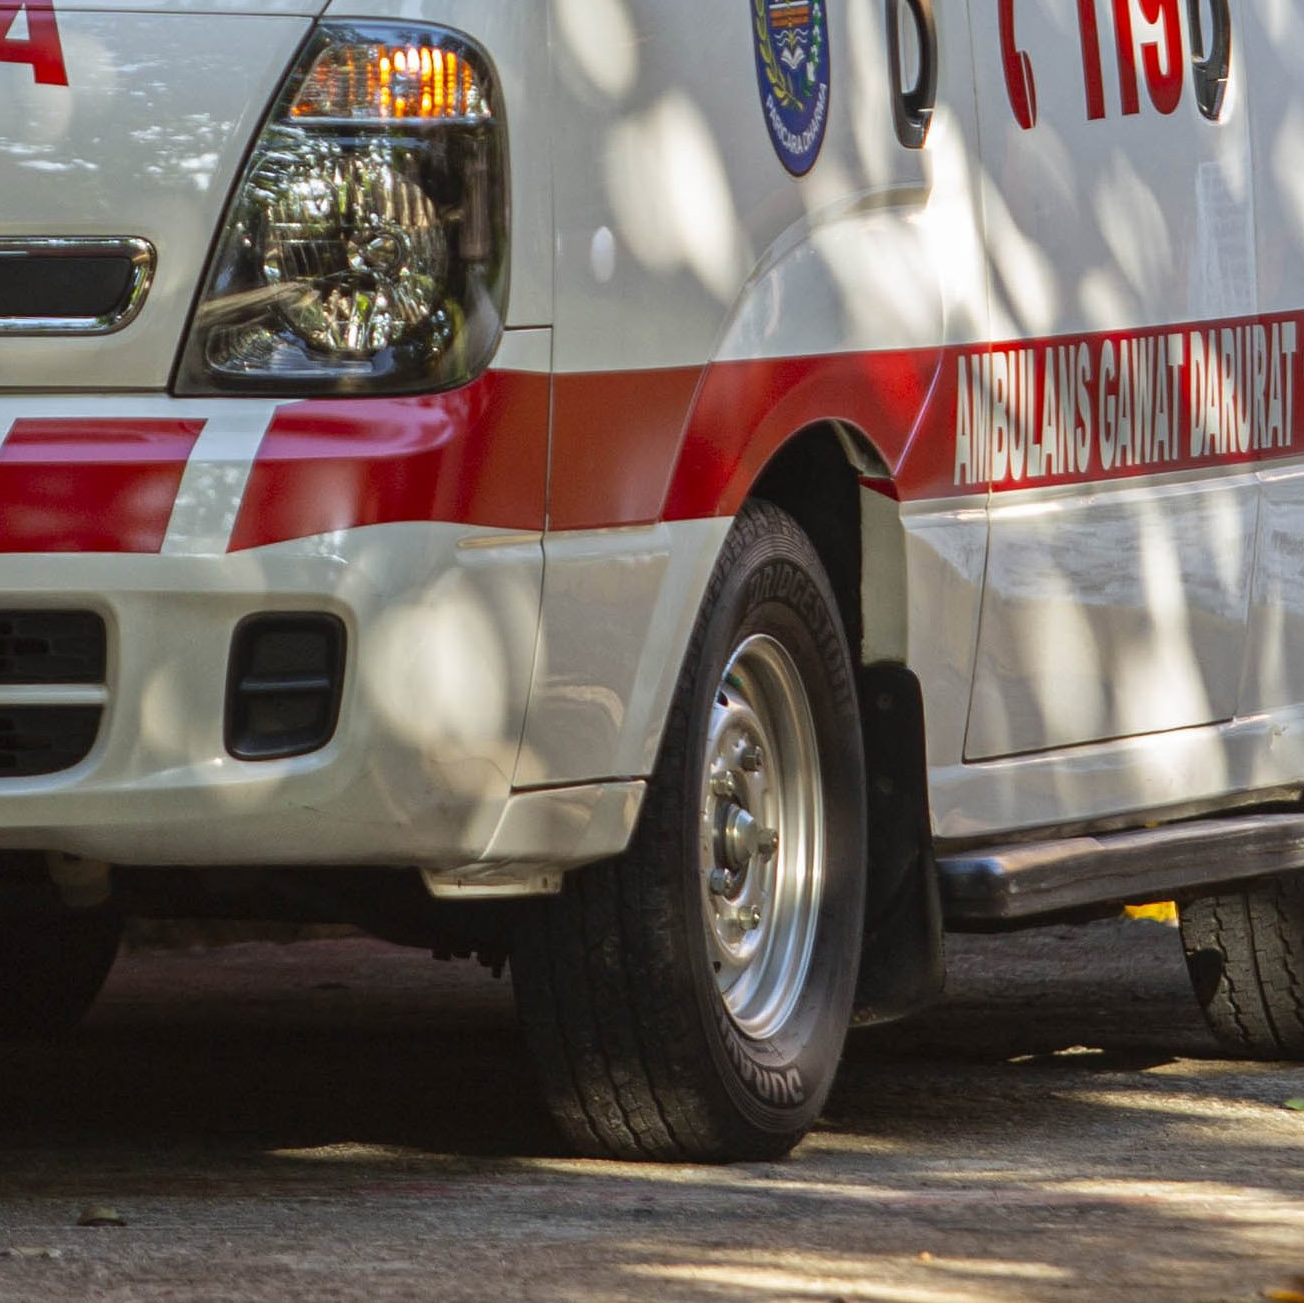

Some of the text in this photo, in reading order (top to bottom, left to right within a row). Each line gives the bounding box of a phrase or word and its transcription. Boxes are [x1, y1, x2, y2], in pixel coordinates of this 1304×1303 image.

[953, 339, 1091, 487] AMBULANS
[1096, 331, 1185, 471] GAWAT
[1189, 321, 1298, 458] DARURAT
